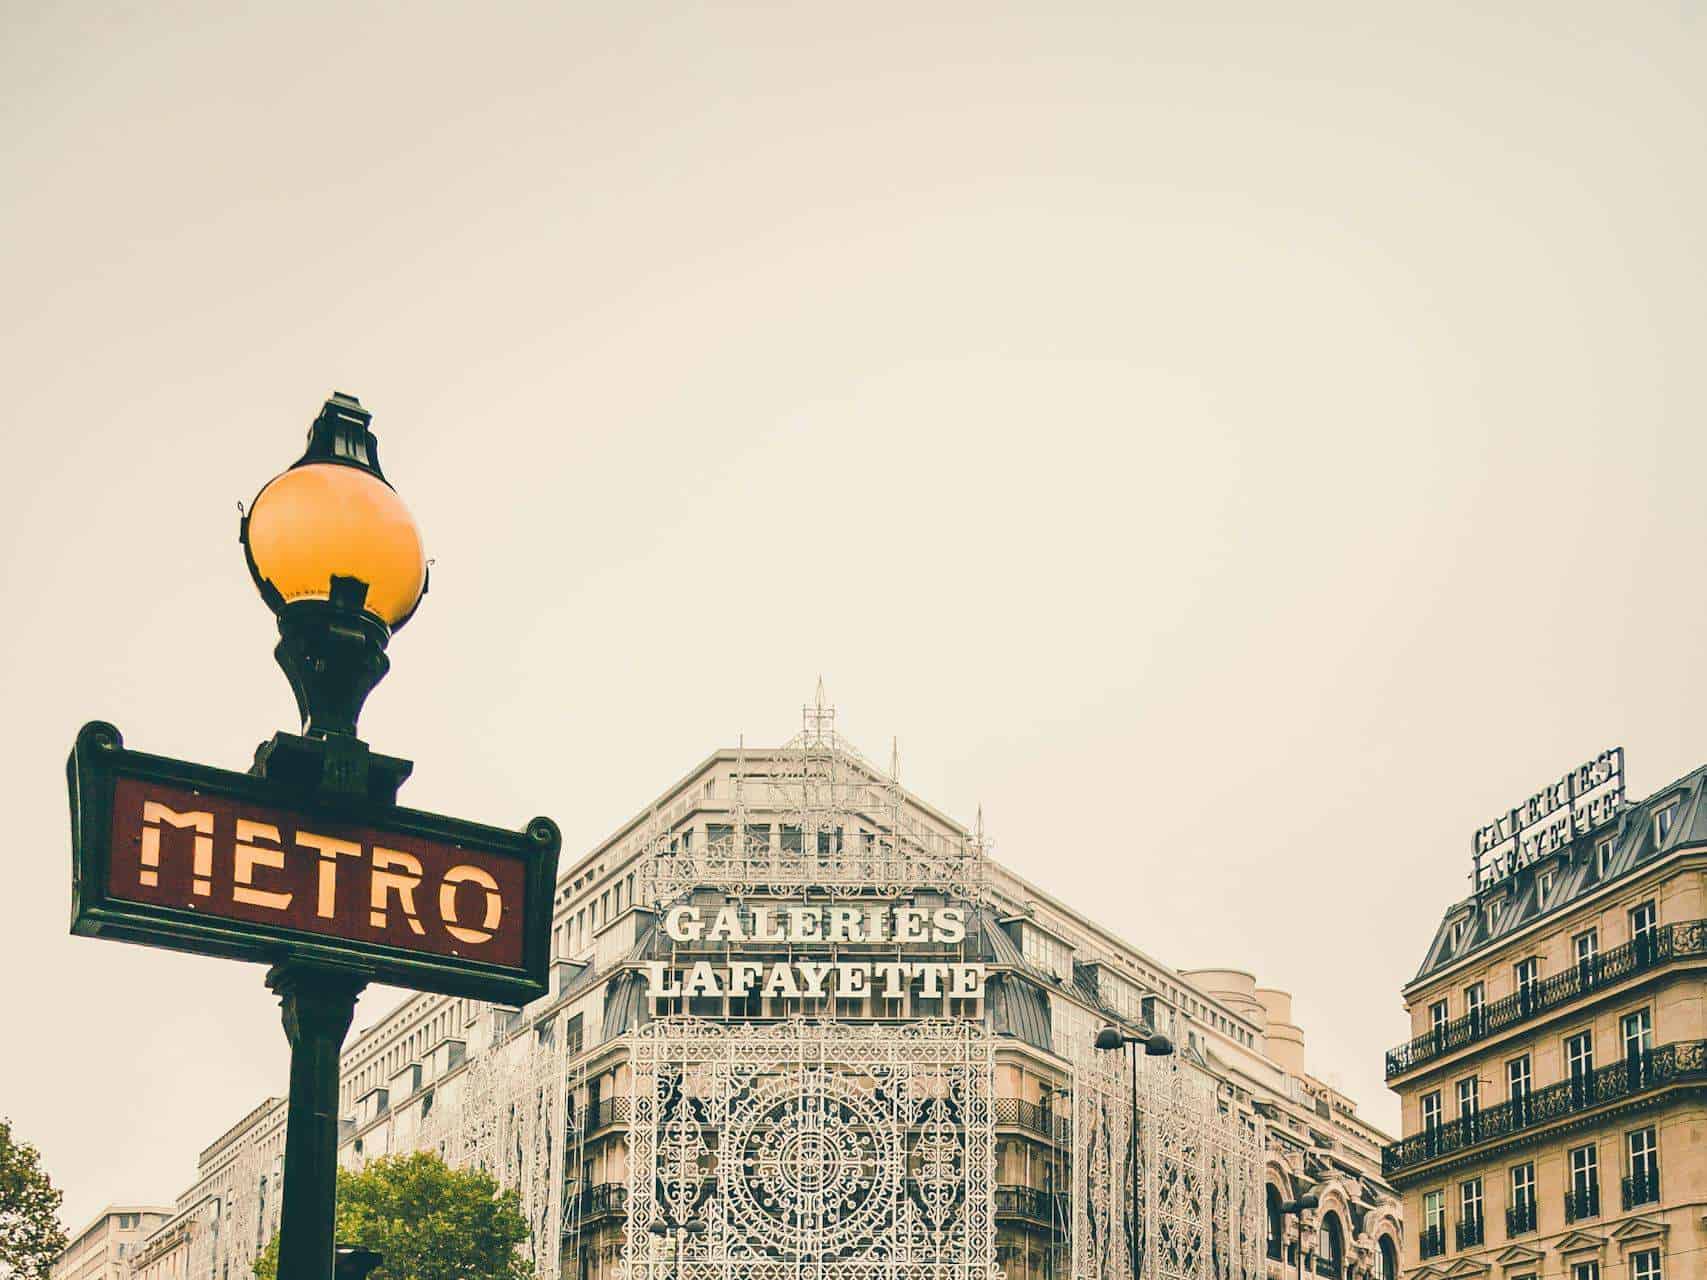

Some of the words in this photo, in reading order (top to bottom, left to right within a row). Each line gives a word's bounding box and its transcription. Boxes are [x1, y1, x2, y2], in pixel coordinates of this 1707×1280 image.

[138, 800, 503, 944] METRO
[665, 906, 967, 943] GALERIES
[645, 960, 986, 998] LAFAYETTE
